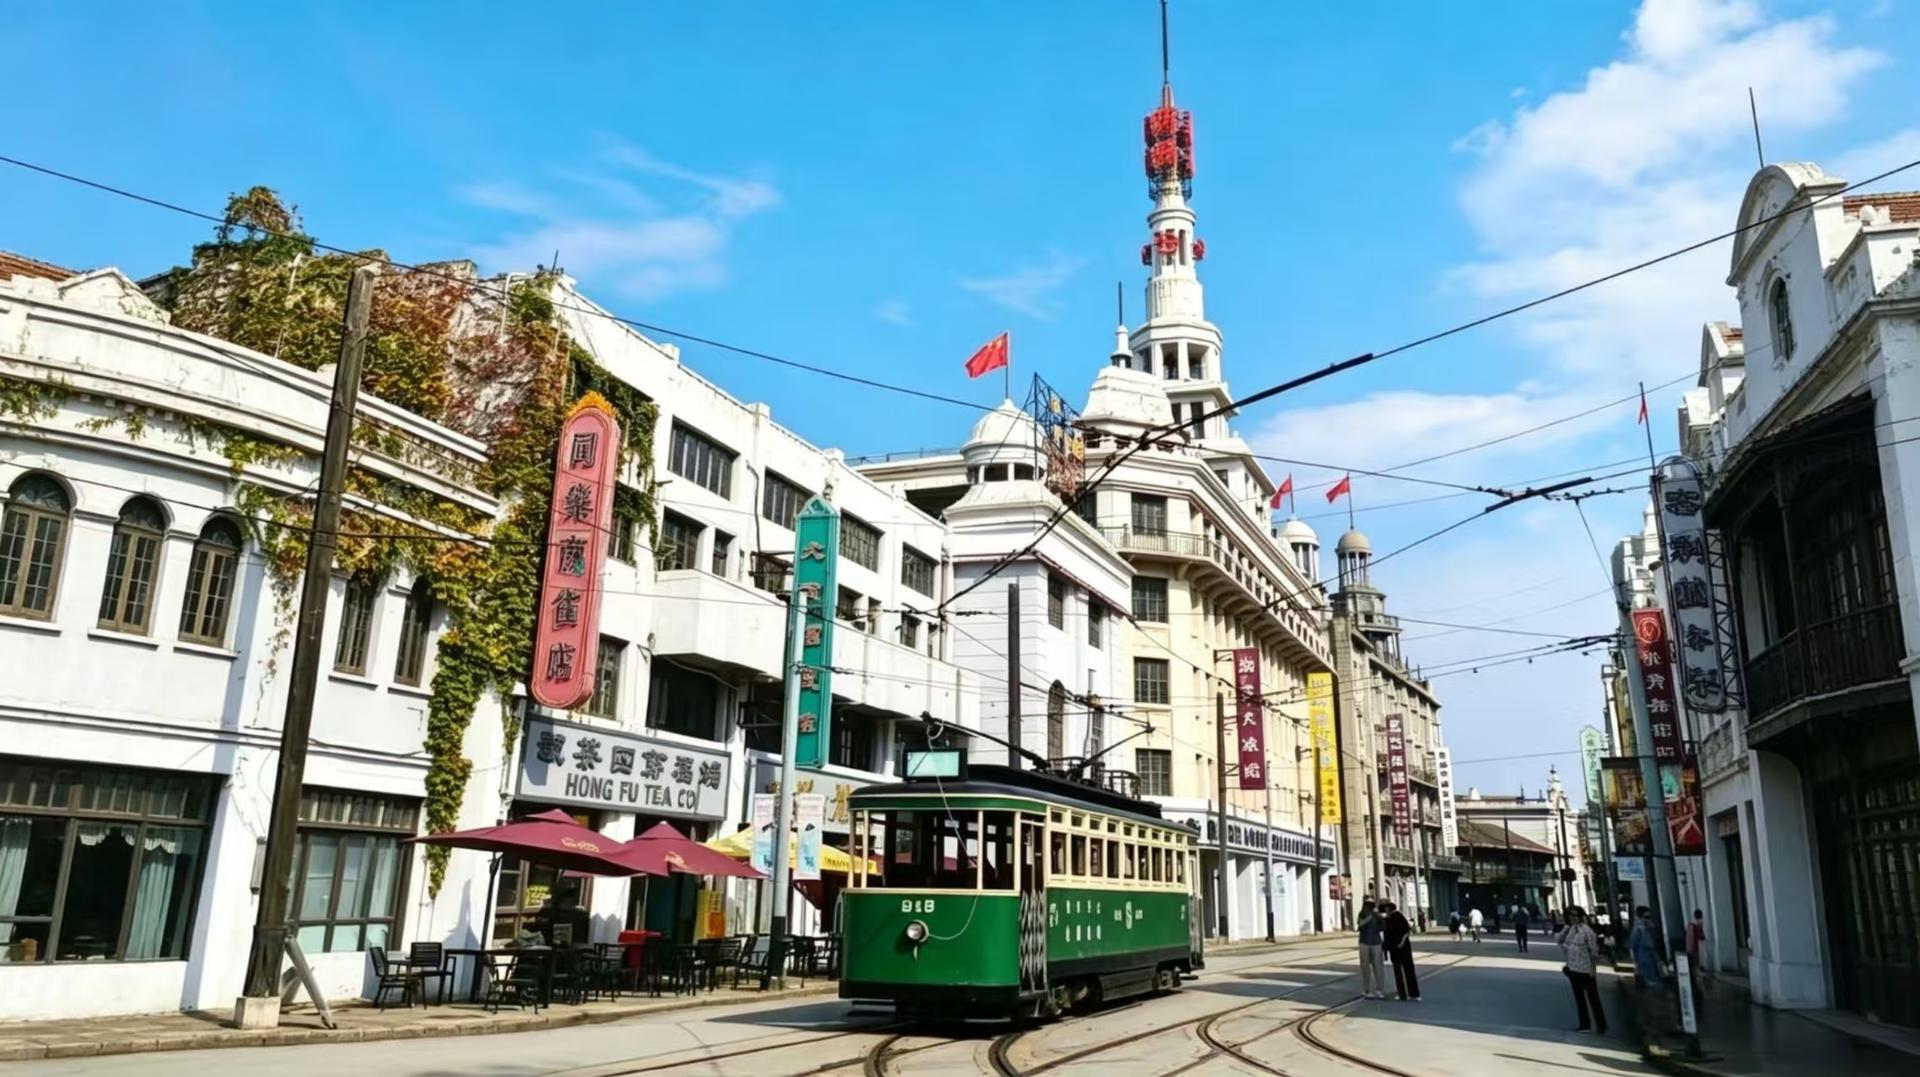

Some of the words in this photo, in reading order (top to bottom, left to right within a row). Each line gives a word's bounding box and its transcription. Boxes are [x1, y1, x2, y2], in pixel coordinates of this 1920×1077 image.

[564, 772, 613, 802] HONG
[618, 780, 639, 803] FU
[644, 783, 672, 808] TEA
